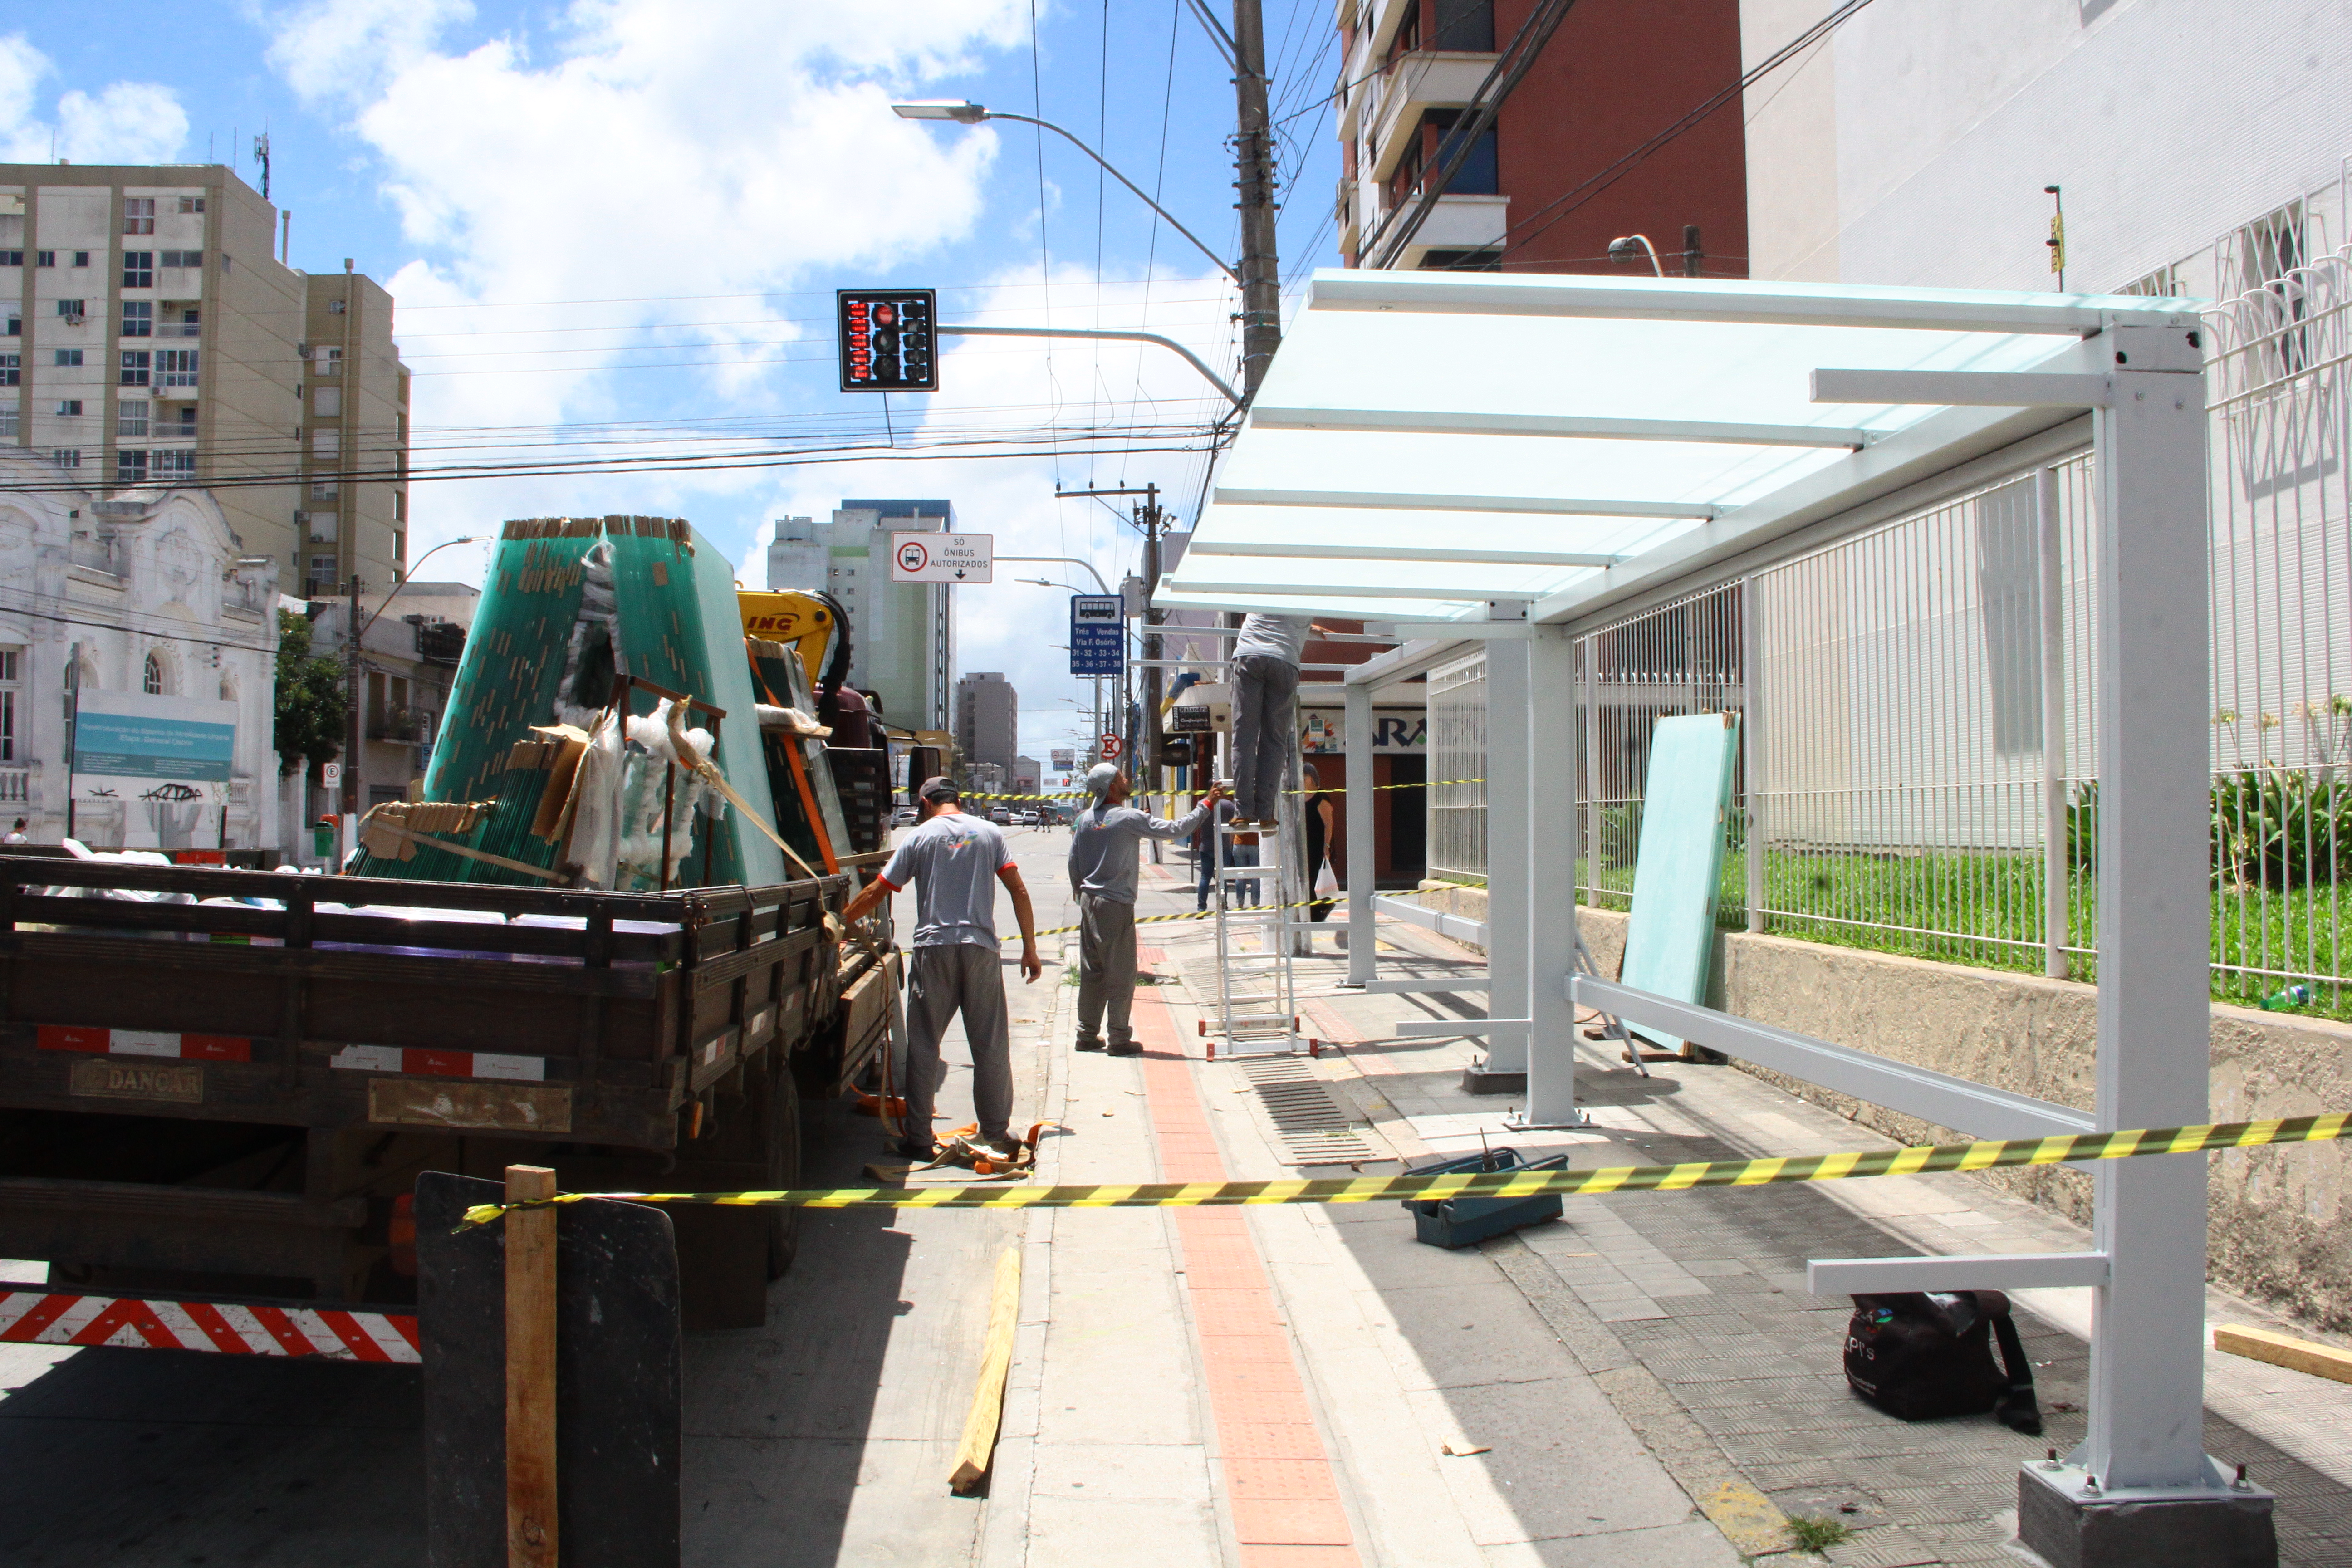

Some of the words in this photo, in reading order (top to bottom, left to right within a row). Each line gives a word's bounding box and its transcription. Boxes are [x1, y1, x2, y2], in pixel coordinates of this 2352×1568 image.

[954, 536, 965, 545] SÓ
[944, 547, 975, 557] ÔNIBUS
[747, 616, 793, 631] ING
